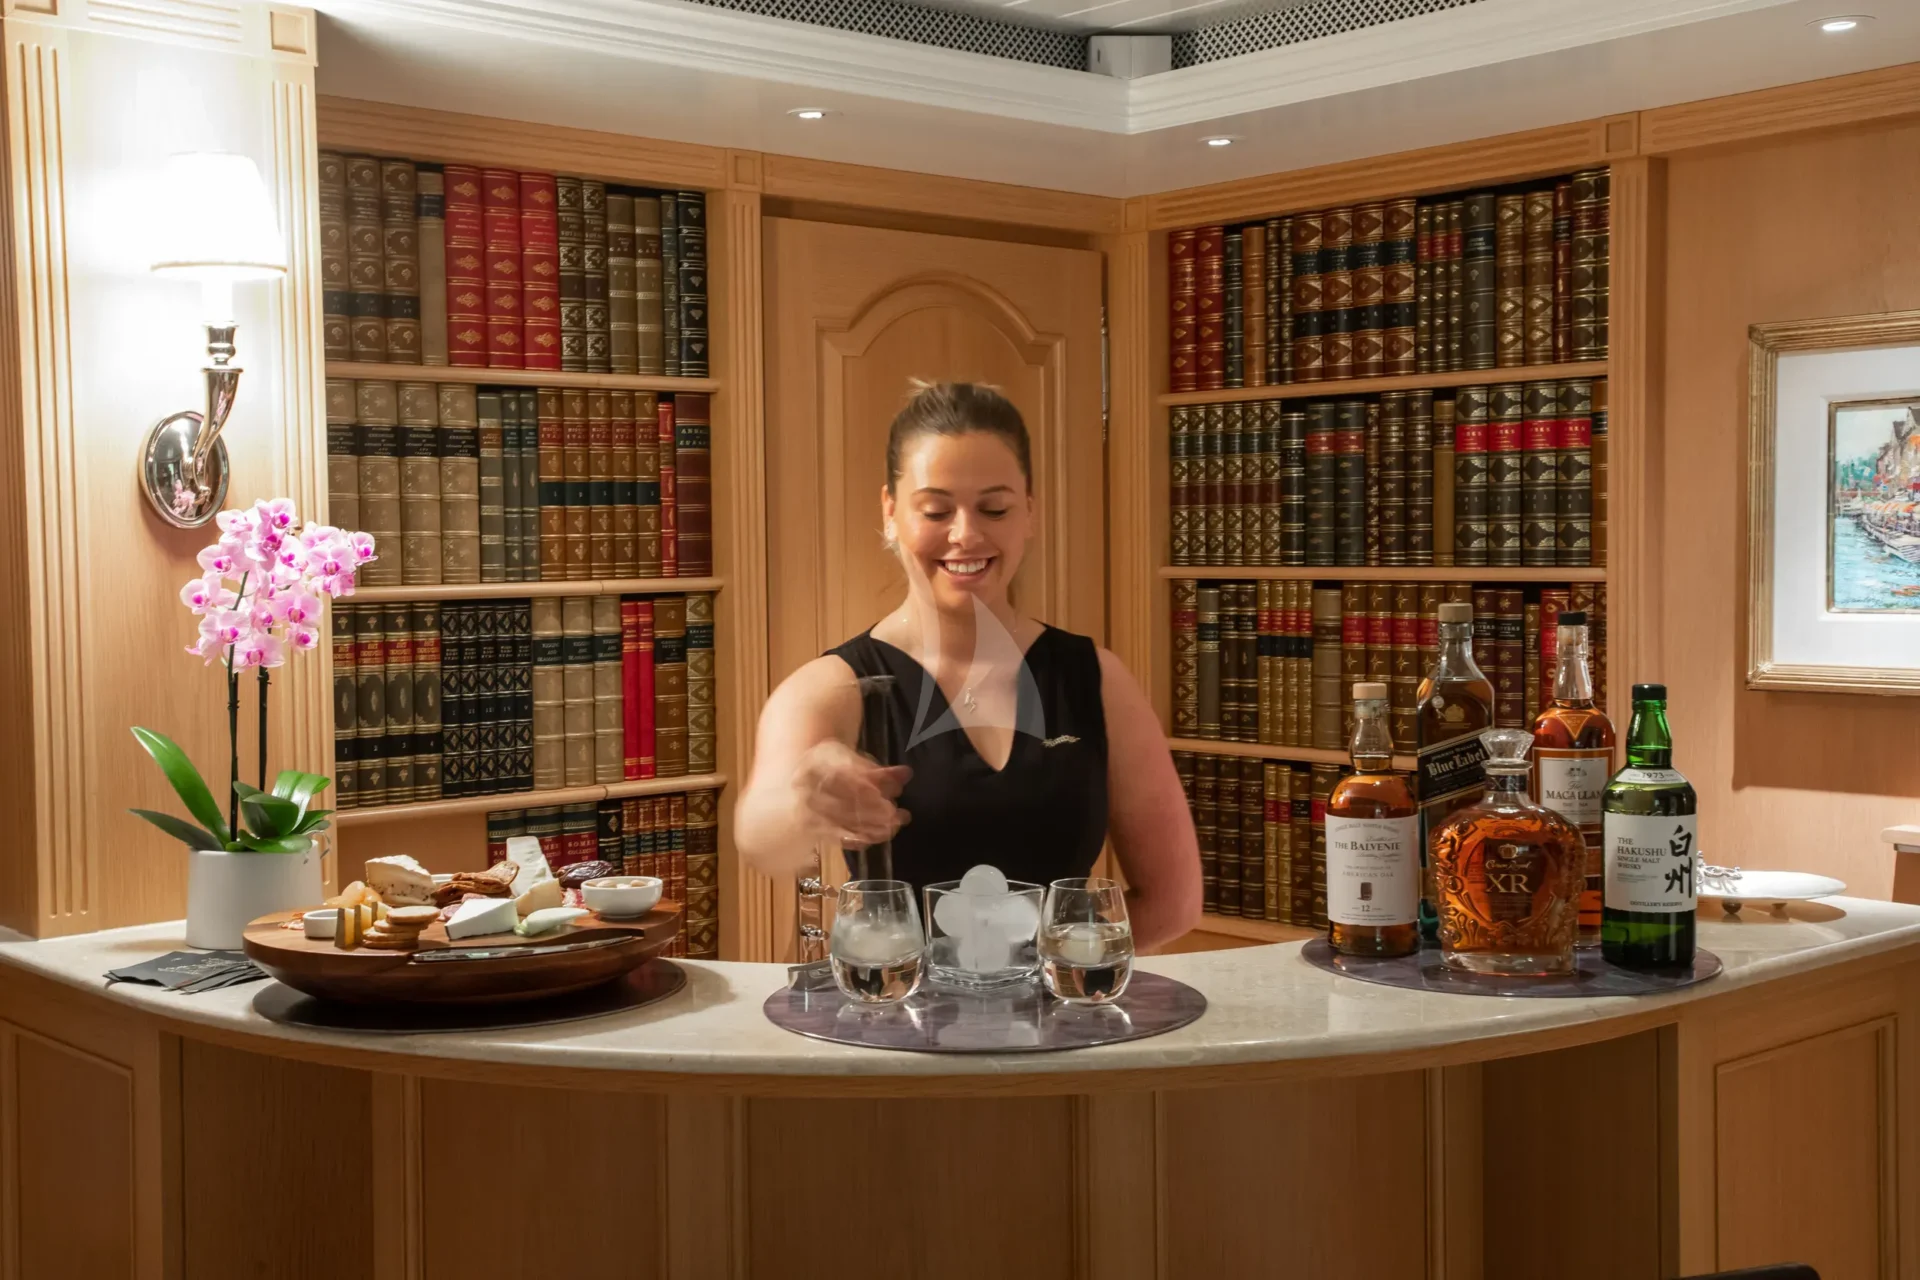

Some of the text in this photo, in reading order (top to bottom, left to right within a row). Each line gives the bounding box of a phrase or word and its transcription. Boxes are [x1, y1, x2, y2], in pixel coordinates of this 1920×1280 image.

[1426, 760, 1455, 778] Blue
[1453, 748, 1486, 769] Label
[1334, 841, 1349, 850] THE
[1617, 836, 1634, 846] THE
[1617, 845, 1667, 857] HAKUSHU
[1664, 824, 1693, 899] 白州
[1484, 872, 1533, 894] XR
[1361, 904, 1371, 912] 12
